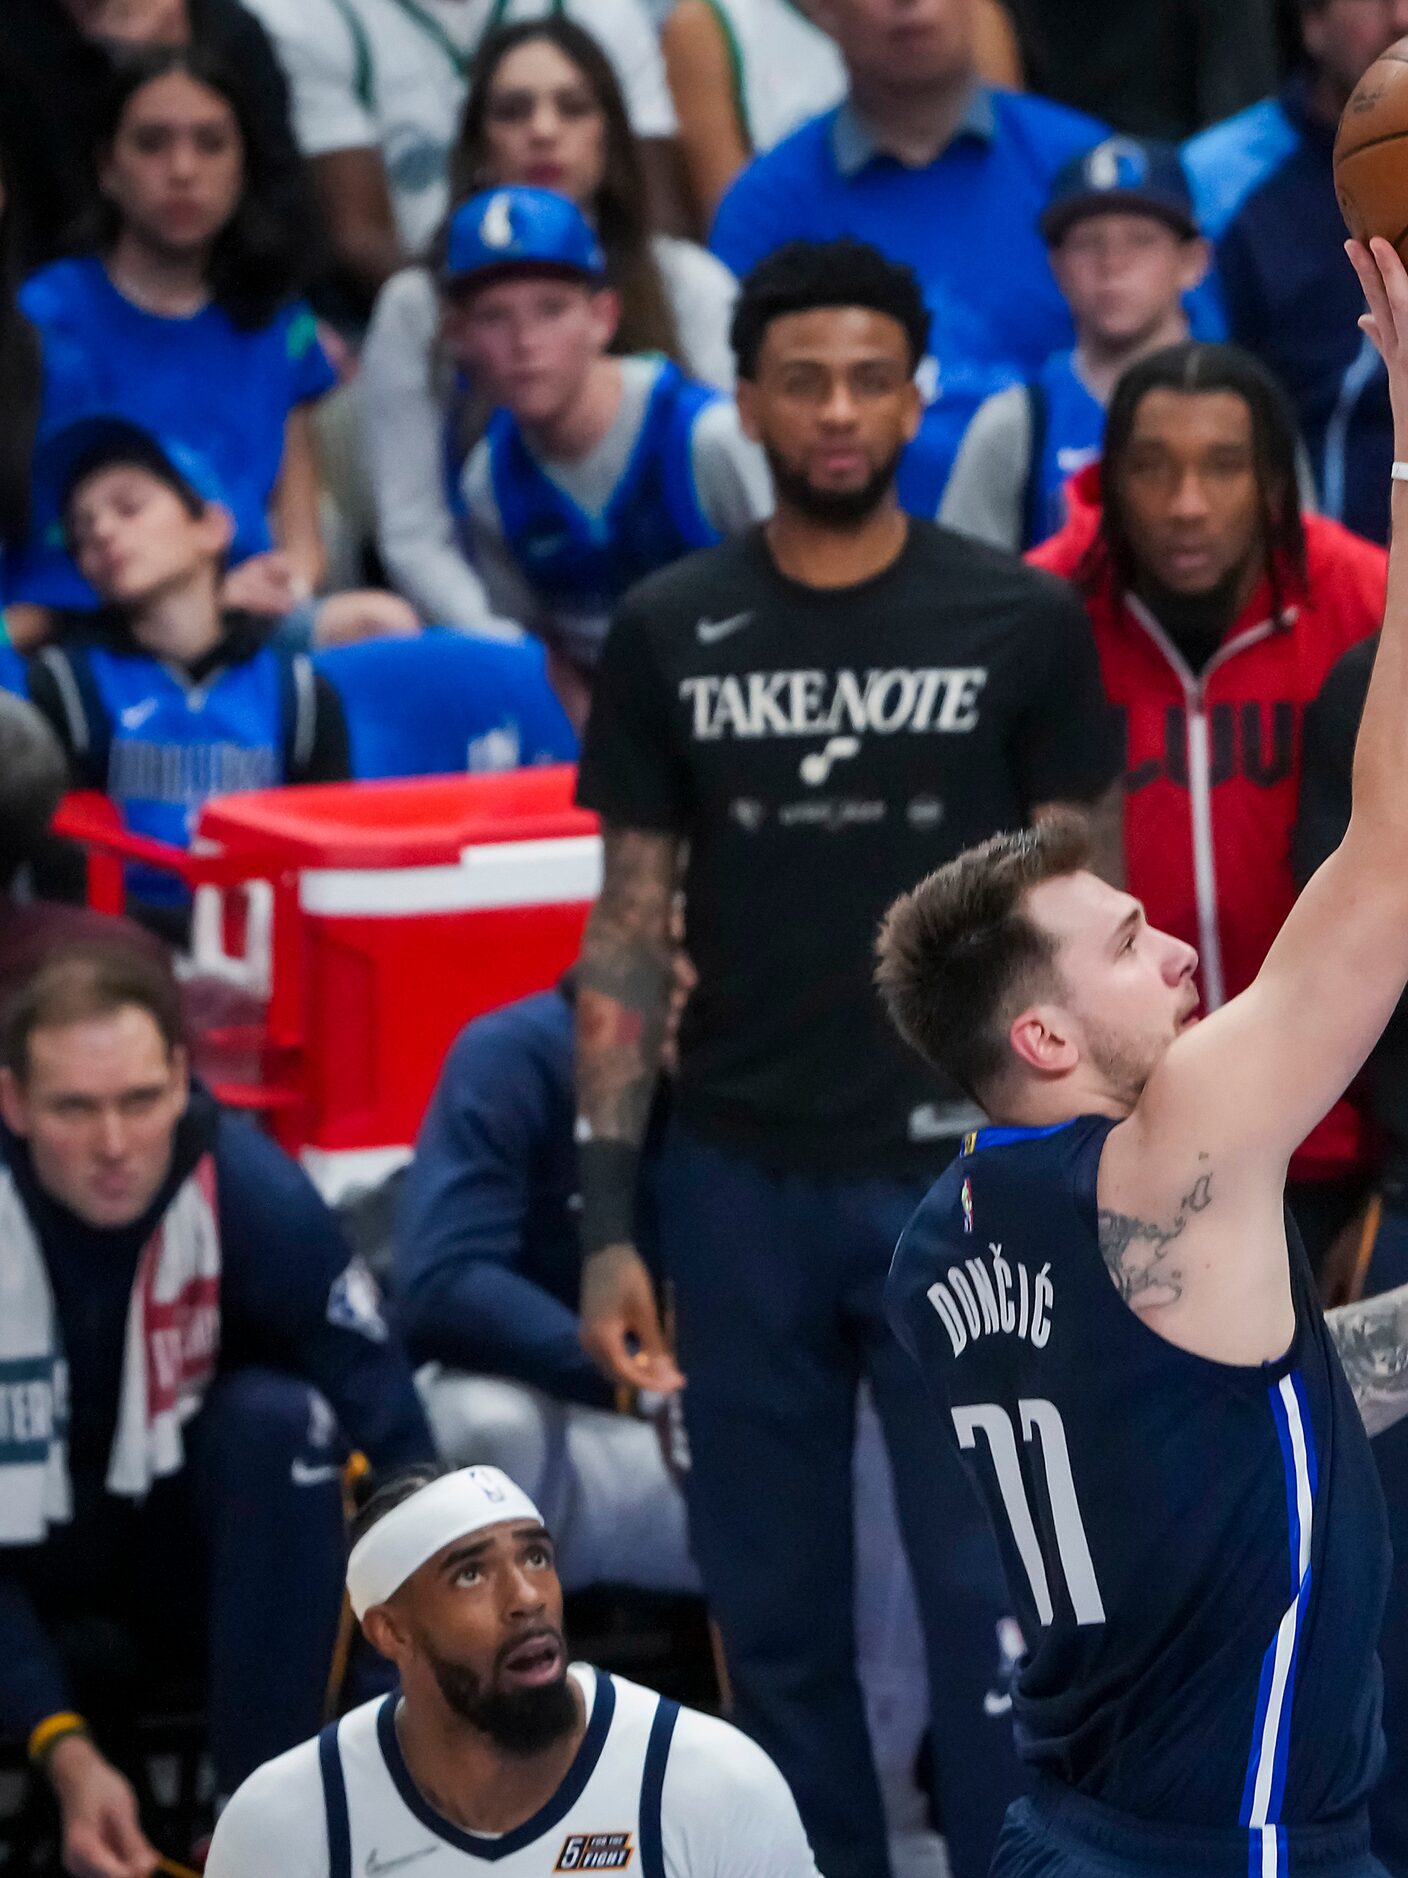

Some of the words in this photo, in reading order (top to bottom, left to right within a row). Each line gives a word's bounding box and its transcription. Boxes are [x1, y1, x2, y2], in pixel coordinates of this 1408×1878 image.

[927, 1242, 1053, 1358] DONČIĆ
[951, 1399, 1105, 1626] 77
[560, 1837, 584, 1869] 5
